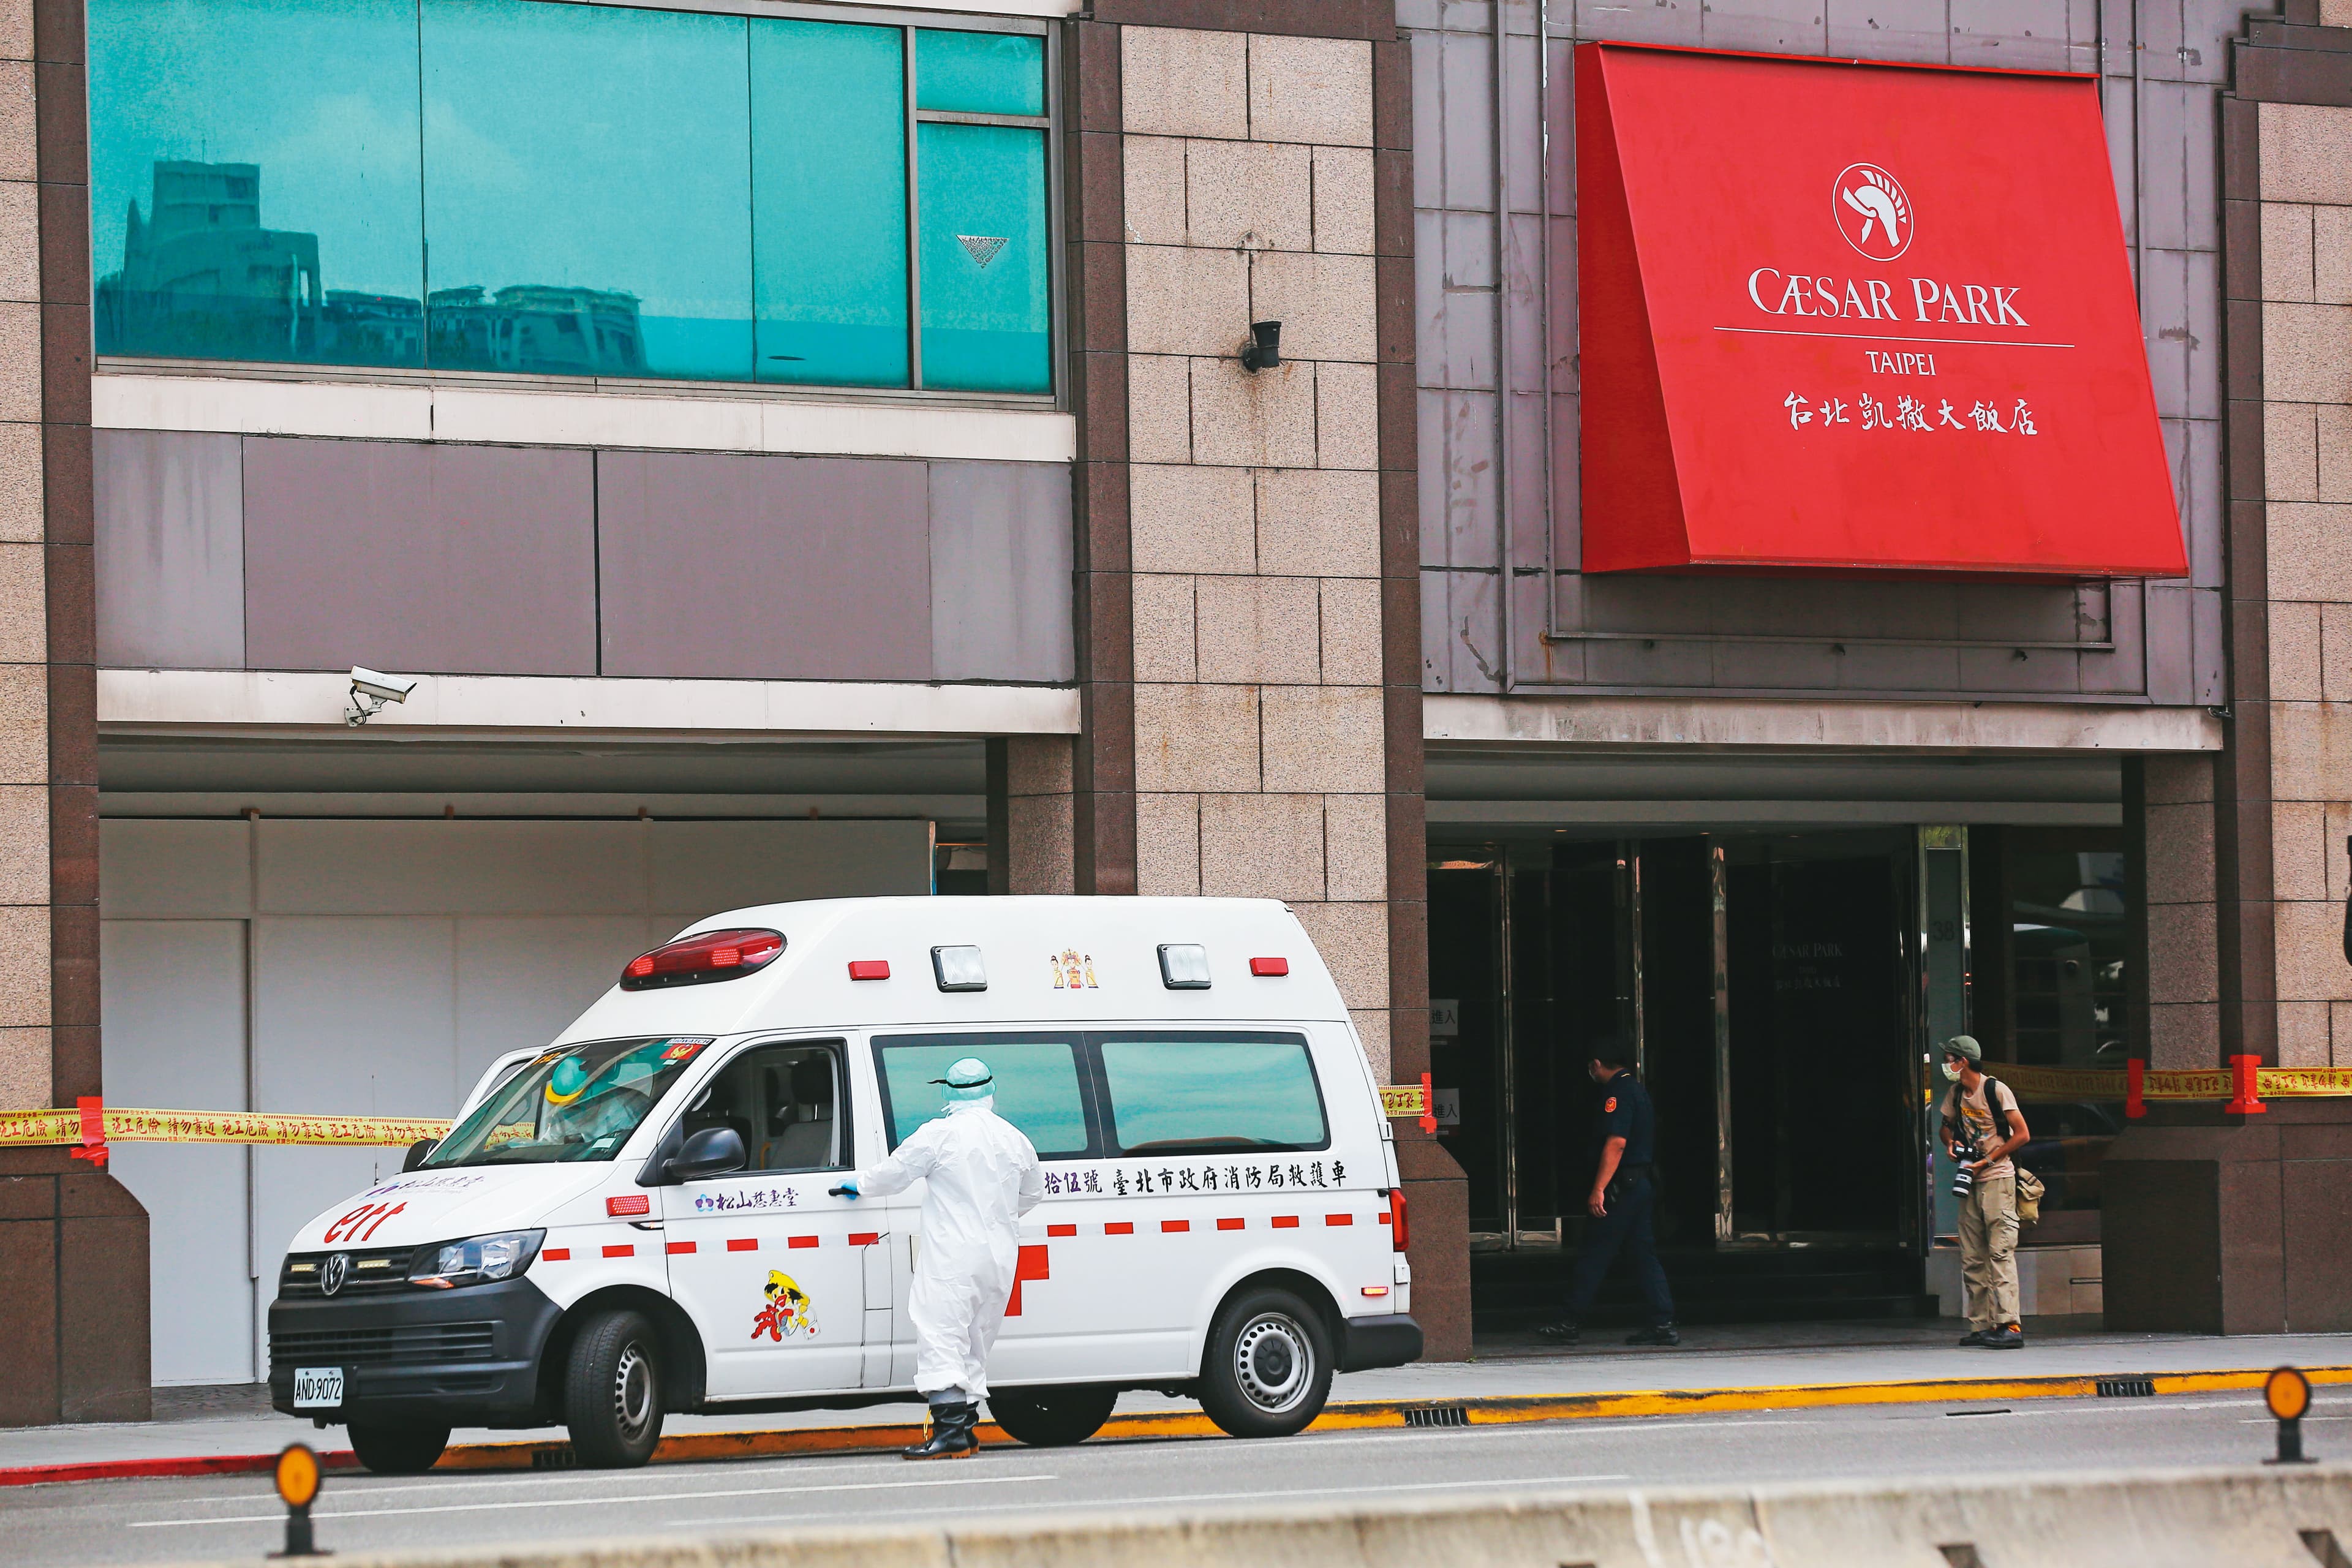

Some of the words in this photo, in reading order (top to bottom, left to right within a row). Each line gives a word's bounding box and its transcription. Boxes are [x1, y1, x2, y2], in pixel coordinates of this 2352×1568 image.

[1908, 277, 2030, 326] PARK
[1865, 350, 1937, 376] TAIPEI
[1783, 391, 2038, 435] 台北凱撒大飯店
[1429, 1009, 1456, 1024] 進入
[55, 1117, 82, 1137] 請勿
[112, 1116, 161, 1135] 施工危險
[167, 1117, 217, 1137] 請勿靠近
[222, 1118, 270, 1137] 施工危險
[276, 1120, 325, 1140] 請勿靠近
[329, 1123, 376, 1140] 施工危險
[382, 1124, 431, 1141] 請勿靠近
[1044, 1169, 1103, 1195] 拾伍號
